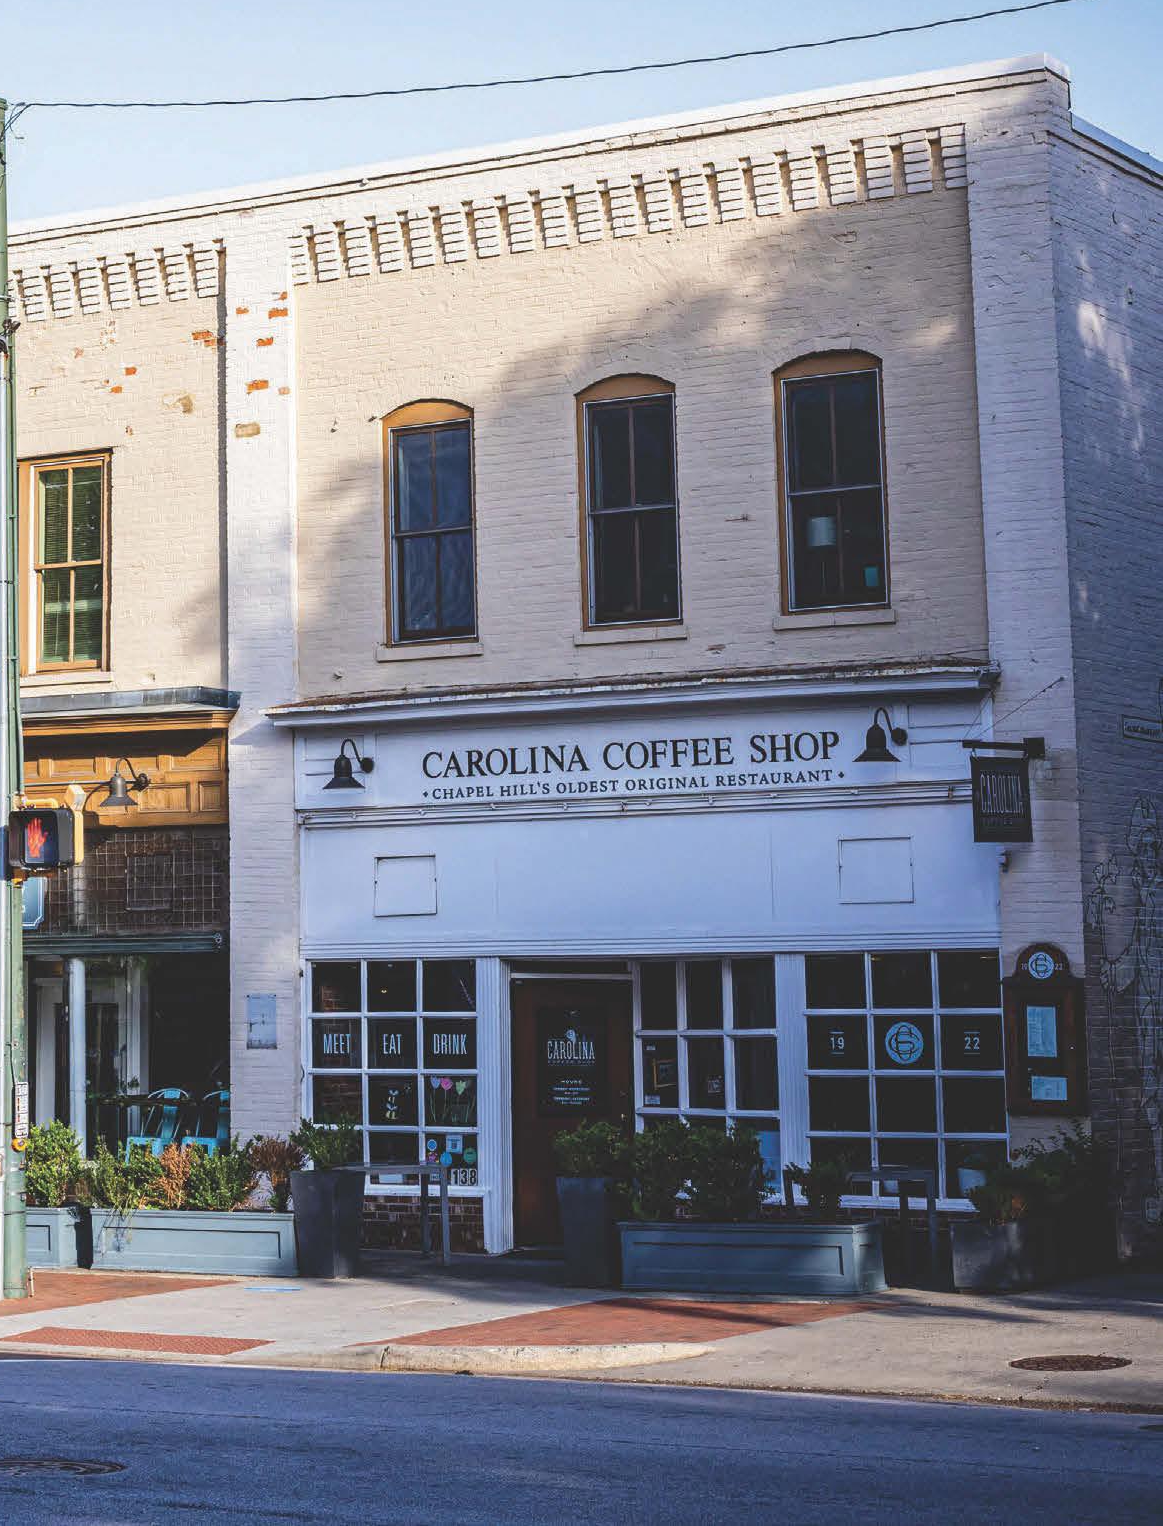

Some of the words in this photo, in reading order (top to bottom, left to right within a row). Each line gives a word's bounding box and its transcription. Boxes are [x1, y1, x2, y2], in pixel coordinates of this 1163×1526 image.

[422, 744, 590, 779] CAROLINA
[602, 736, 735, 771] COFFEE
[749, 731, 840, 763] SHOP
[432, 785, 494, 800] CHAPEL
[500, 781, 550, 797] HILL'S
[556, 780, 619, 794] OLDEST
[625, 776, 709, 791] ORIGINAL
[716, 769, 833, 787] RESTAURANT
[323, 1033, 351, 1054] MEET
[383, 1033, 402, 1054] EAT
[433, 1033, 468, 1055] DRINK
[547, 1040, 595, 1060] CAROLINA
[830, 1036, 845, 1050] 19
[964, 1036, 981, 1050] 22
[452, 1169, 477, 1185] 138
